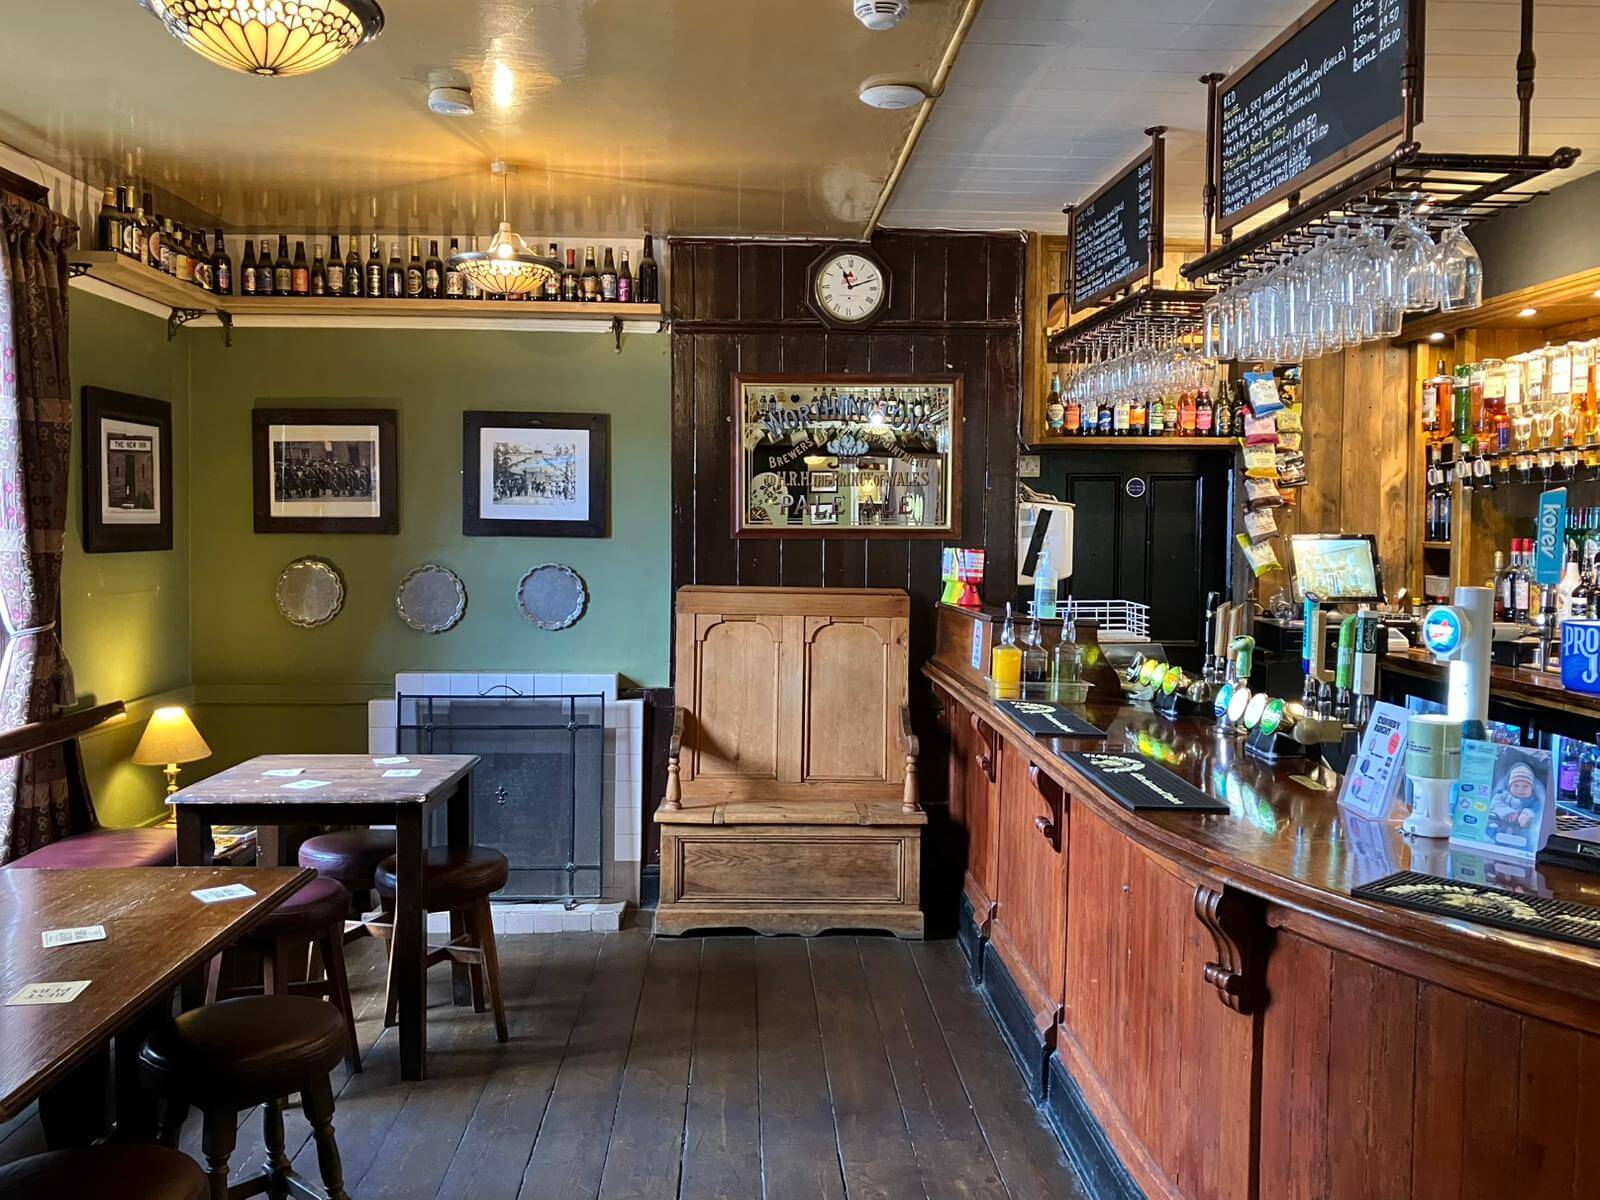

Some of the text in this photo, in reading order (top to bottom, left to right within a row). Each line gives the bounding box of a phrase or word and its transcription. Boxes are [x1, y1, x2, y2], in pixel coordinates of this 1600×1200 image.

[1224, 91, 1236, 109] RED
[768, 439, 814, 469] BREWERS
[864, 430, 930, 469] APPOINTMENT
[813, 473, 832, 488] THE
[885, 470, 930, 487] WALES
[779, 494, 914, 516] PALE ALE
[1541, 503, 1562, 561] korev
